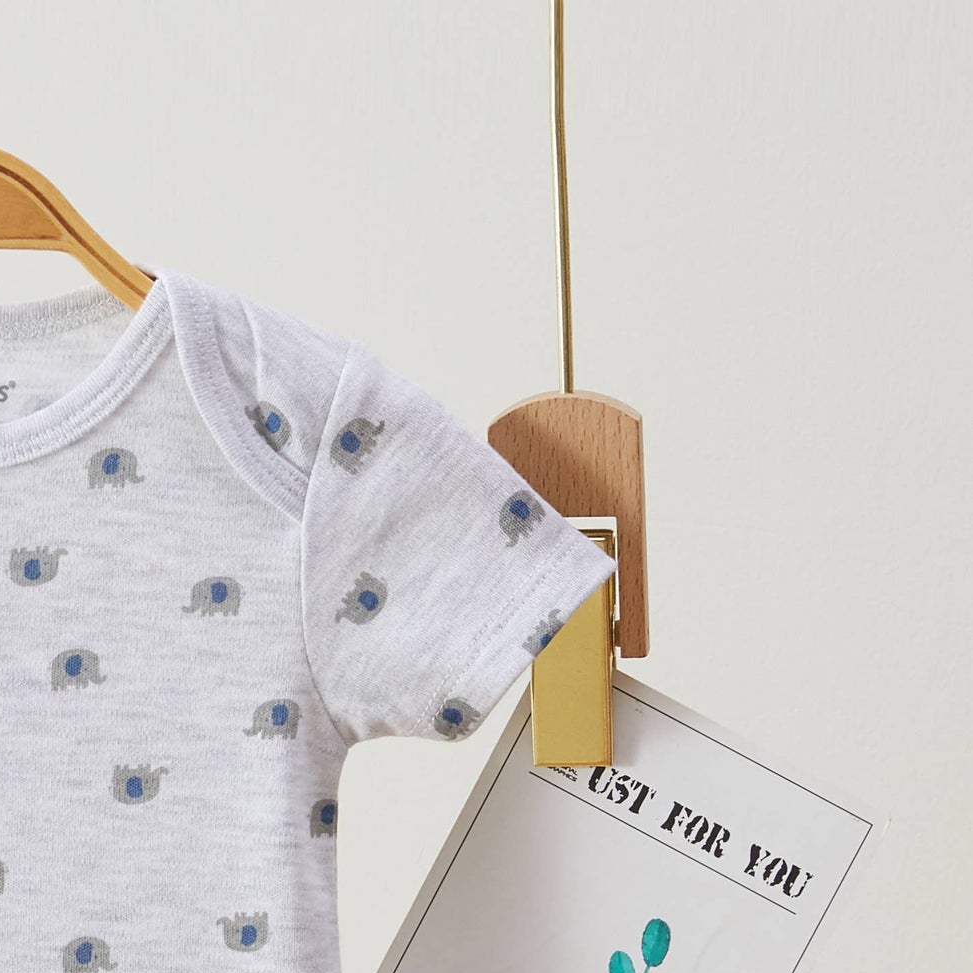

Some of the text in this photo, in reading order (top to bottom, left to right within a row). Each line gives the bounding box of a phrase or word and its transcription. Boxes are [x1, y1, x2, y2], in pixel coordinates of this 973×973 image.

[587, 766, 814, 898] UST FOR YOU
